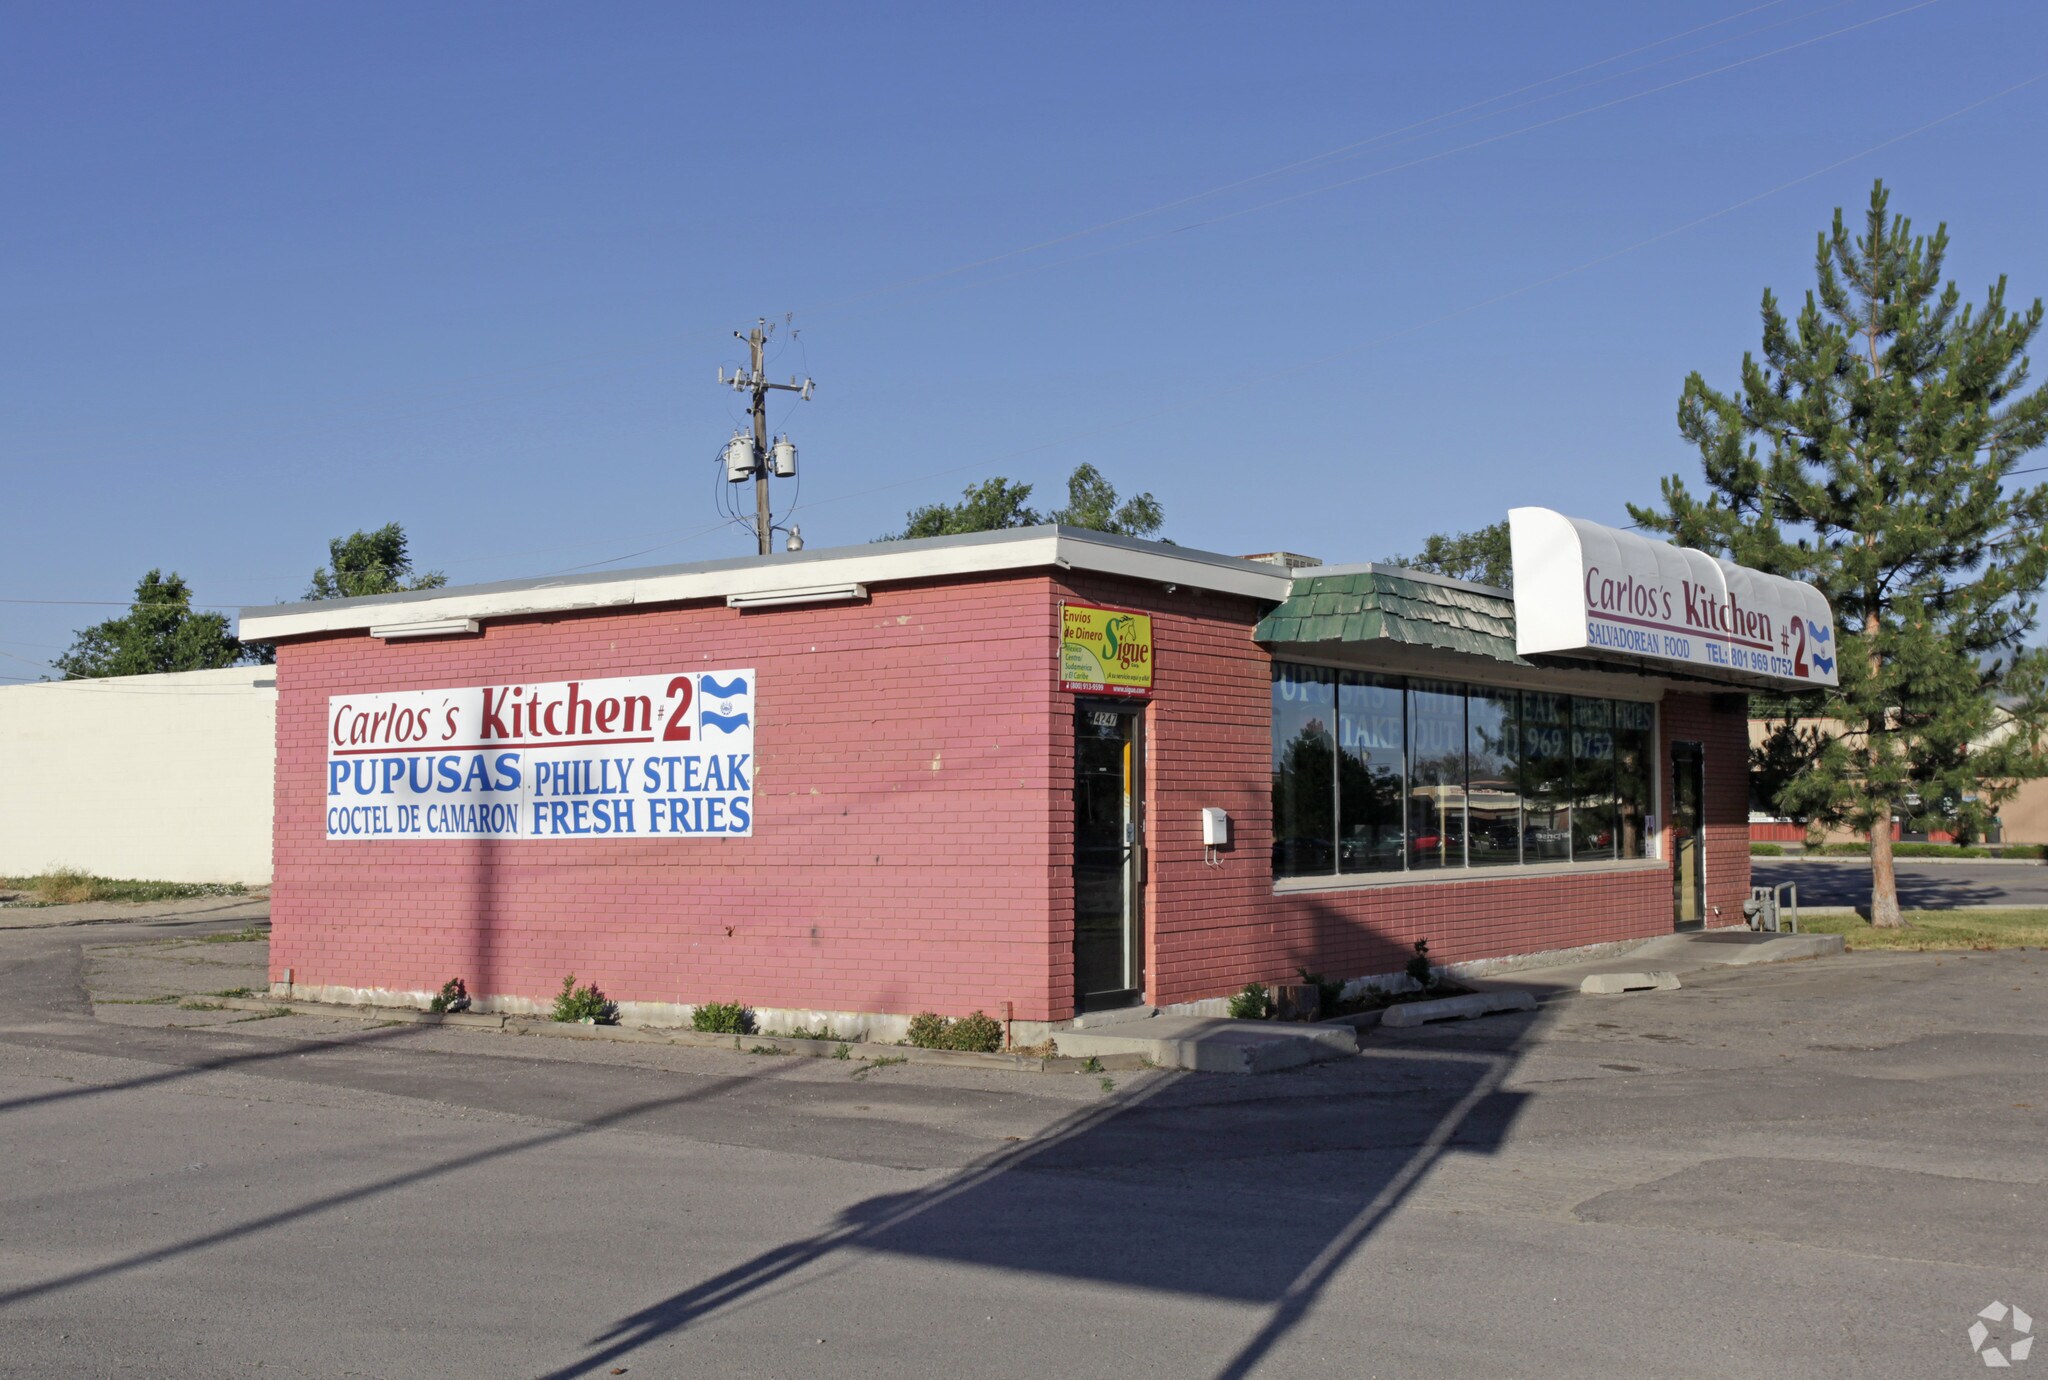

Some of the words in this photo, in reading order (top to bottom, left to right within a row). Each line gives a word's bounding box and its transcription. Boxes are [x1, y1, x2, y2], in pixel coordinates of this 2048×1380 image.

[1682, 580, 1773, 642] Kitchen
[1064, 626, 1075, 639] de
[1076, 627, 1103, 641] Dinero
[1102, 617, 1149, 670] Sigue
[1588, 622, 1660, 654] SALVADOREAN
[1664, 635, 1690, 659] FOOD
[1705, 643, 1729, 665] TEL:
[1731, 647, 1749, 669] 801
[1751, 651, 1769, 672] 969
[1771, 655, 1794, 676] 0752
[480, 682, 652, 741] Kitchen
[1095, 712, 1117, 725] 4247
[1571, 697, 1613, 728] FRESH
[1616, 700, 1652, 731] FRIES
[1339, 713, 1402, 749] TAKE
[1411, 718, 1458, 752] OUT
[1527, 727, 1562, 757] 969
[1572, 731, 1614, 760] 0752
[328, 752, 521, 796] PUPUSAS
[534, 758, 635, 797] PHILLY
[643, 754, 750, 794] STEAK
[328, 806, 393, 835] COCTEL
[398, 804, 421, 834] DE
[426, 803, 519, 834] CAMARON
[531, 799, 635, 835] FRESH
[649, 796, 750, 834] FRIES
